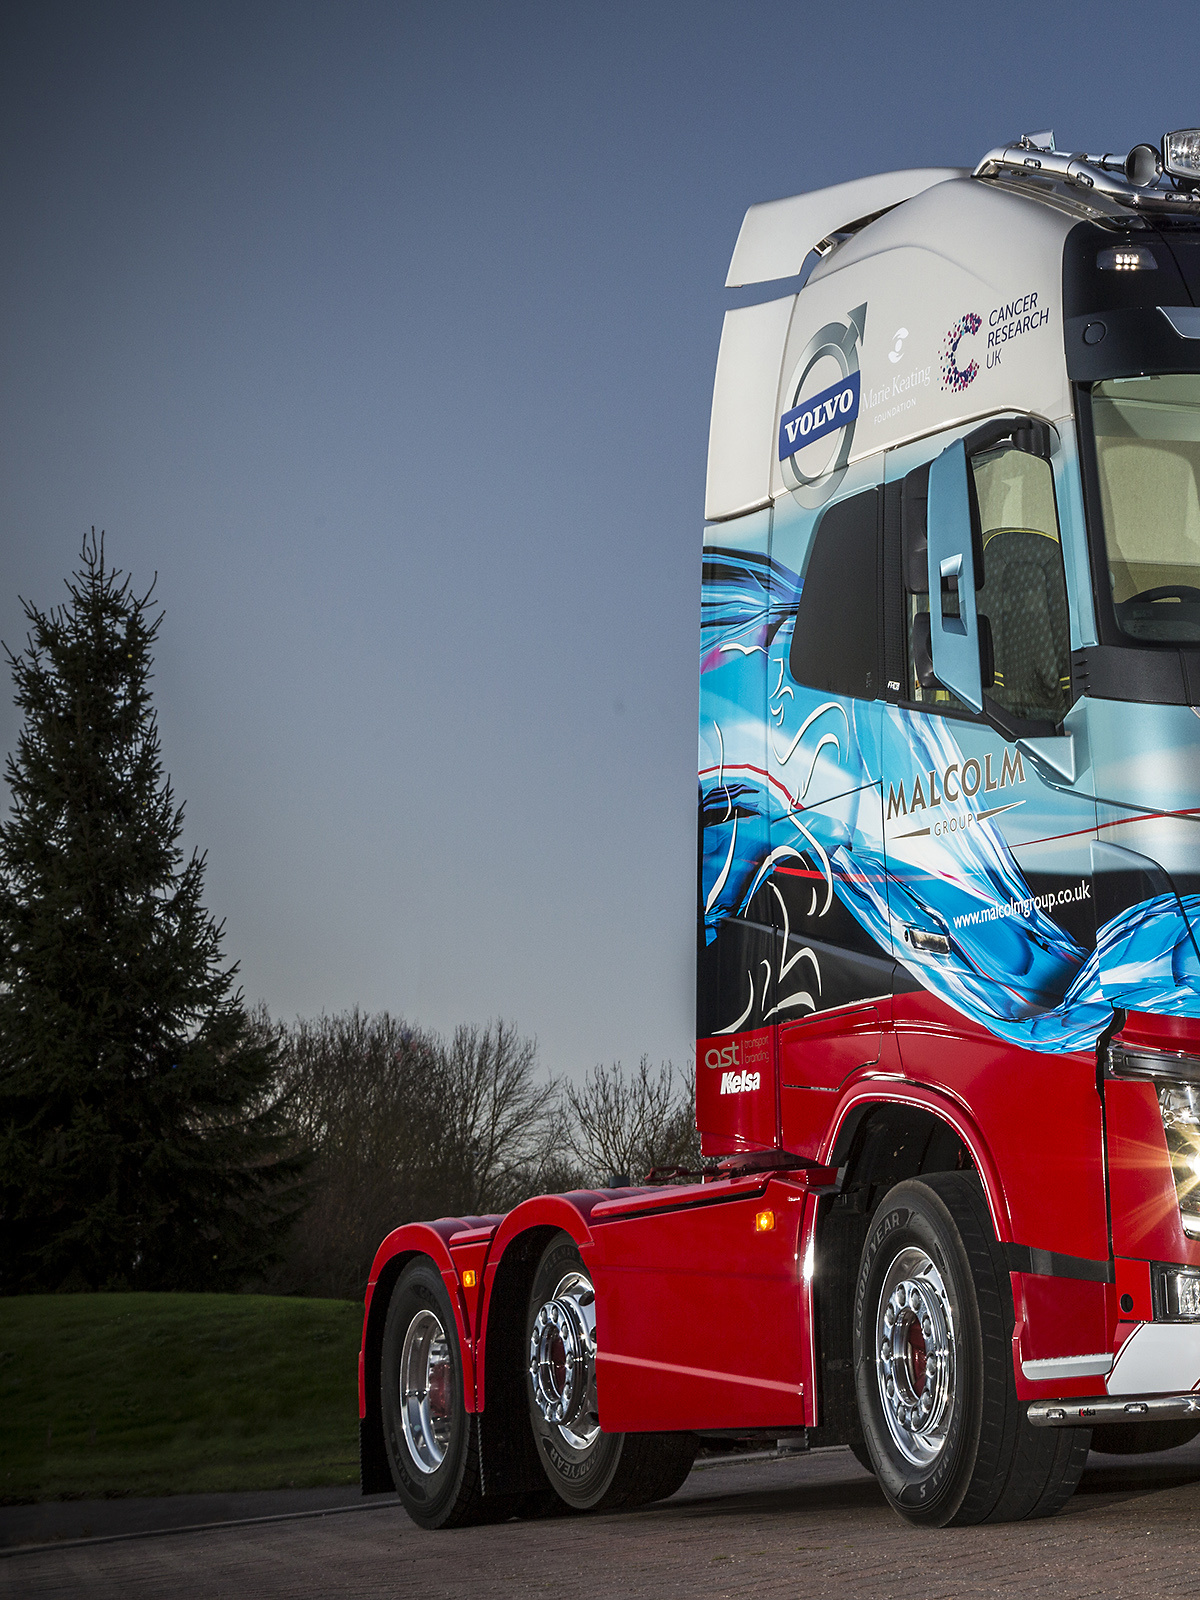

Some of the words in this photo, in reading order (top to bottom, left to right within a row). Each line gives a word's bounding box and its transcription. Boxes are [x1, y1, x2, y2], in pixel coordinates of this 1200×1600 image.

[988, 292, 1038, 326] CANCER
[986, 307, 1050, 349] RESEARCH
[985, 349, 1002, 370] UK
[861, 386, 890, 413] Marie
[891, 366, 931, 402] Keating
[784, 388, 854, 443] VOLVO
[873, 398, 917, 425] FOUNDATION
[887, 747, 1027, 821] MALCOLM
[934, 814, 974, 838] GROUP
[953, 880, 1092, 930] www.malcolmgroup.co.uk
[705, 1041, 739, 1069] ast
[720, 1069, 760, 1095] Kelsa
[1078, 1407, 1096, 1418] Kelsa
